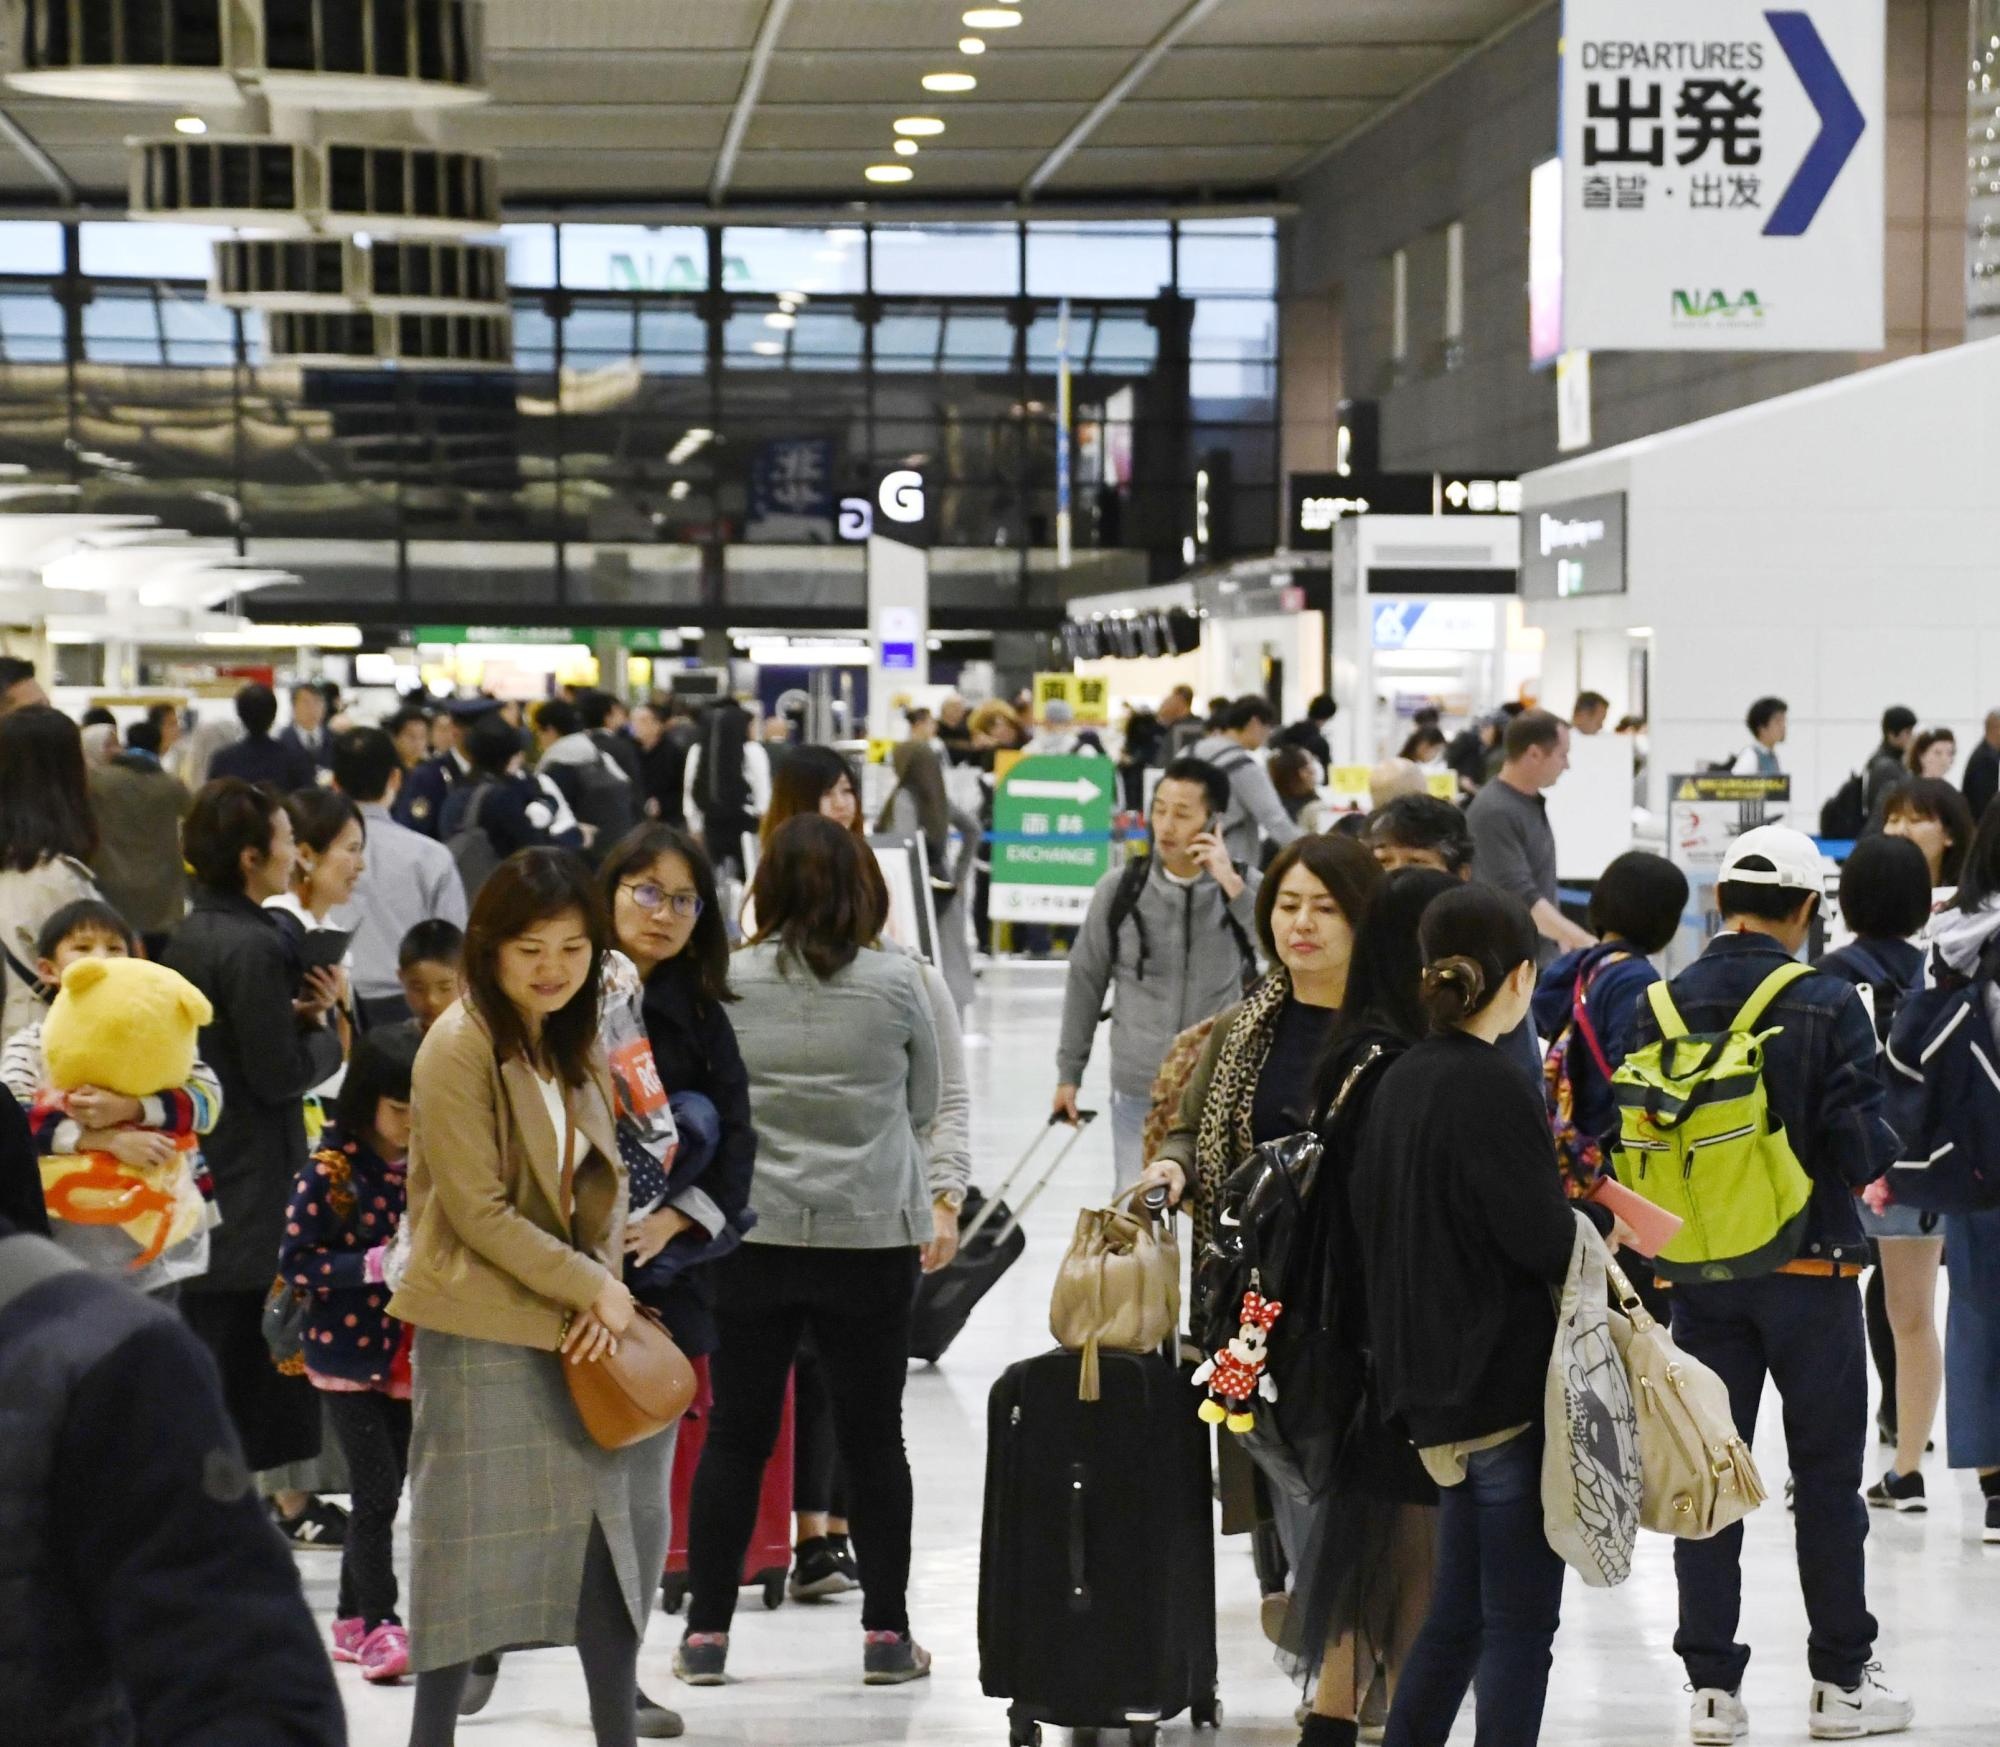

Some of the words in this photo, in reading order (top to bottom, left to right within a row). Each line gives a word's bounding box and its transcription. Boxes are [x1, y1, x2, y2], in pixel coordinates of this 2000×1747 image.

[1582, 42, 1763, 71] DEPARTURES
[1582, 77, 1763, 168] 出発
[1583, 175, 1647, 210] 출발
[1689, 175, 1761, 209] 出发
[1671, 289, 1763, 317] NAA
[879, 470, 925, 523] G
[1006, 844, 1097, 866] EXCHANGE
